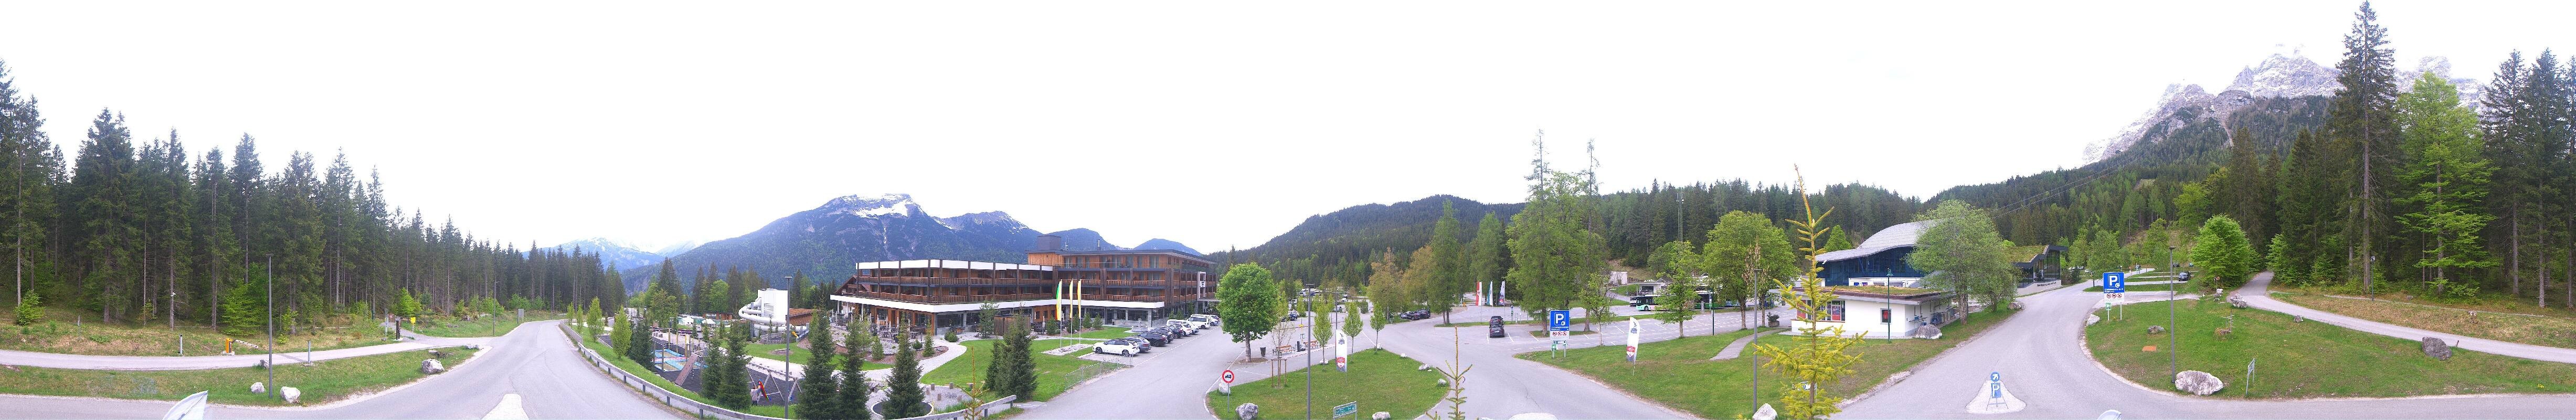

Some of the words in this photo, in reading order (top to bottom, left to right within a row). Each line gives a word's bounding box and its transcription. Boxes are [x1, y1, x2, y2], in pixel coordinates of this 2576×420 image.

[2109, 275, 2118, 286] P
[1555, 313, 1564, 324] P
[1992, 384, 2000, 397] P
